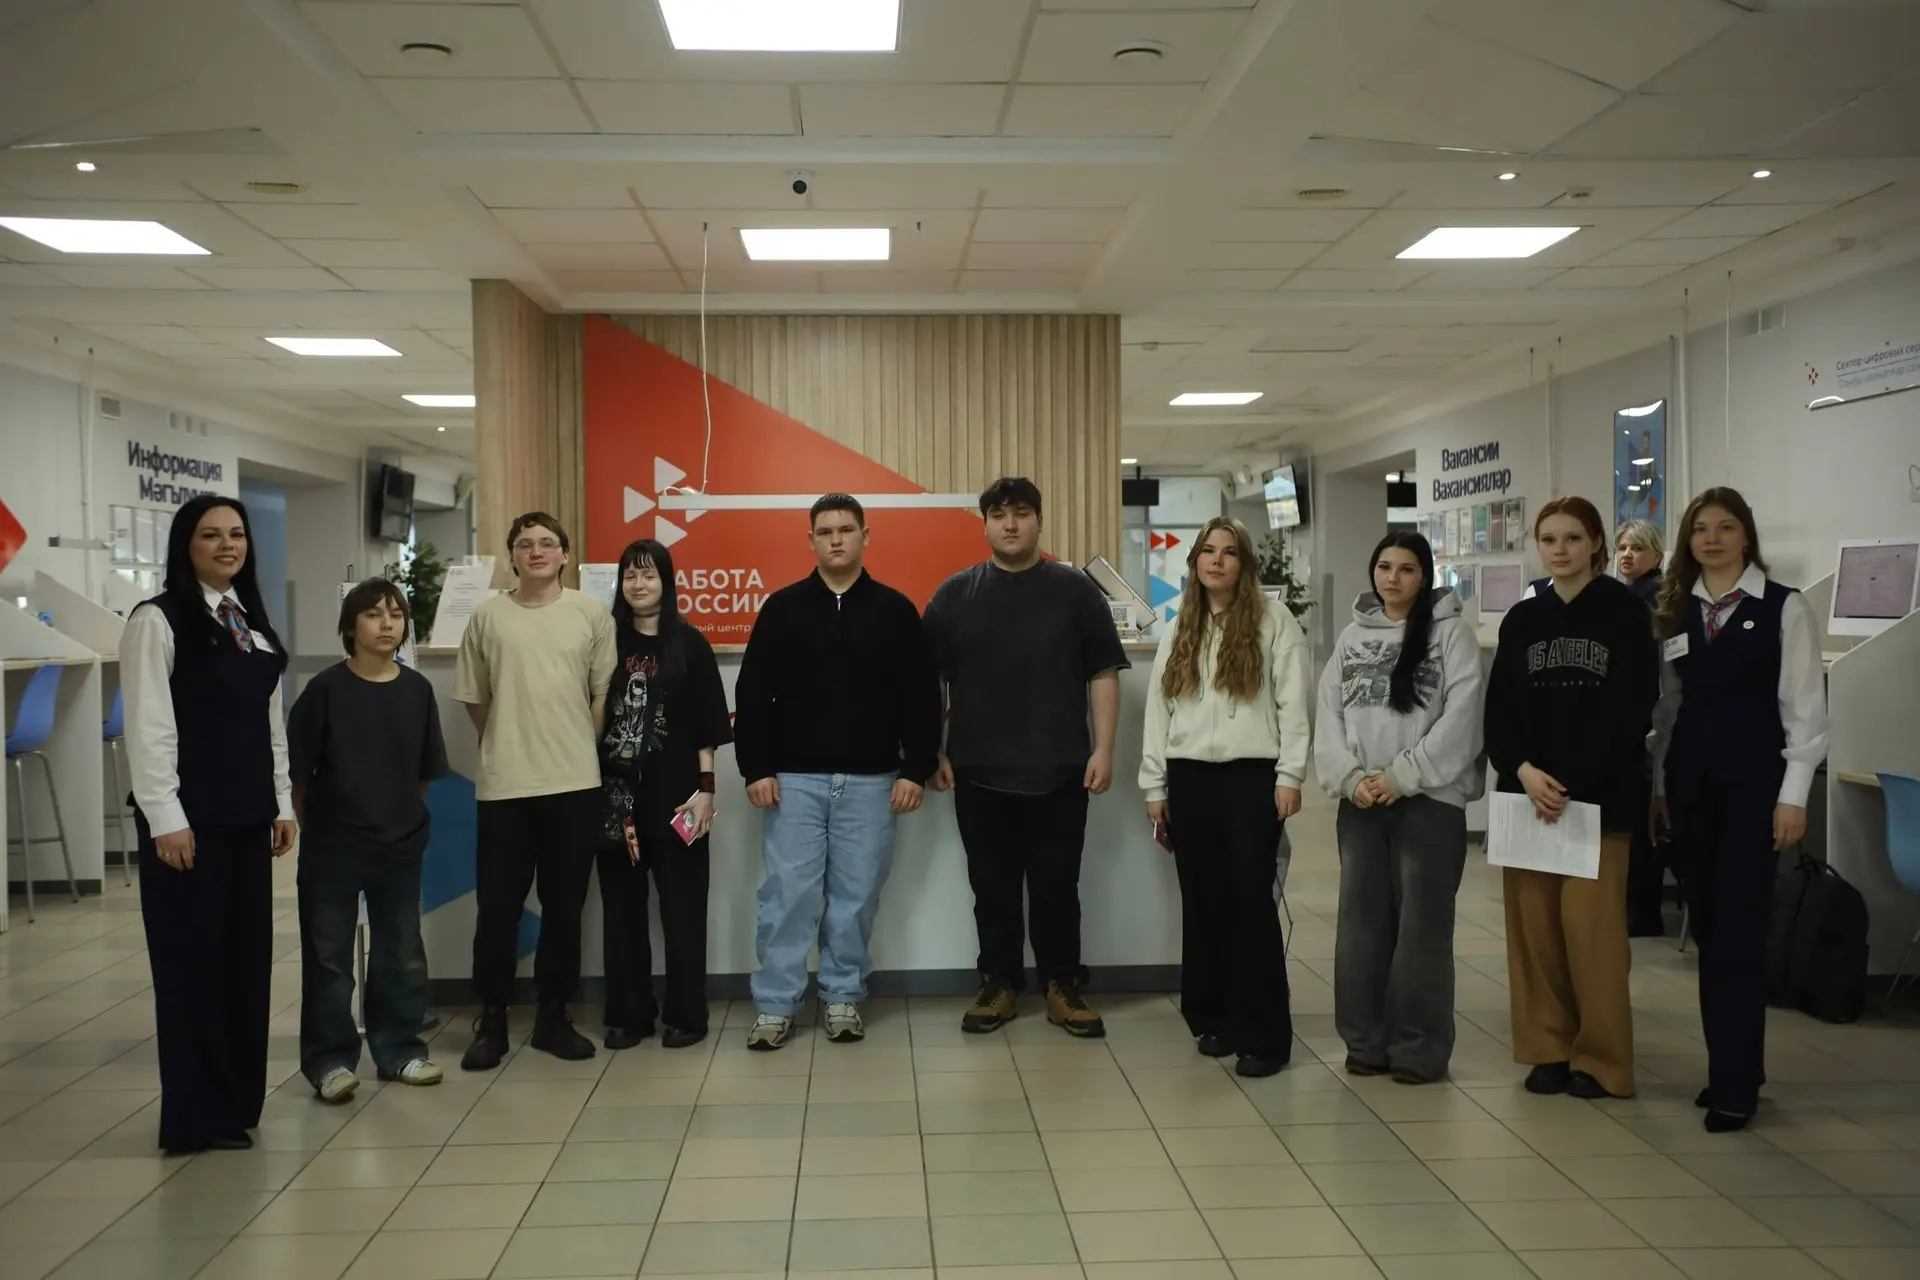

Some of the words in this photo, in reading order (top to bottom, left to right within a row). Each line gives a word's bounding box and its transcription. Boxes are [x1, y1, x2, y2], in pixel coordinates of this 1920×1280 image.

[127, 440, 222, 483] Информация
[1442, 440, 1499, 471] Вакансии
[674, 568, 765, 590] АБОТА
[677, 593, 771, 614] ОССИИ
[717, 624, 751, 634] центр
